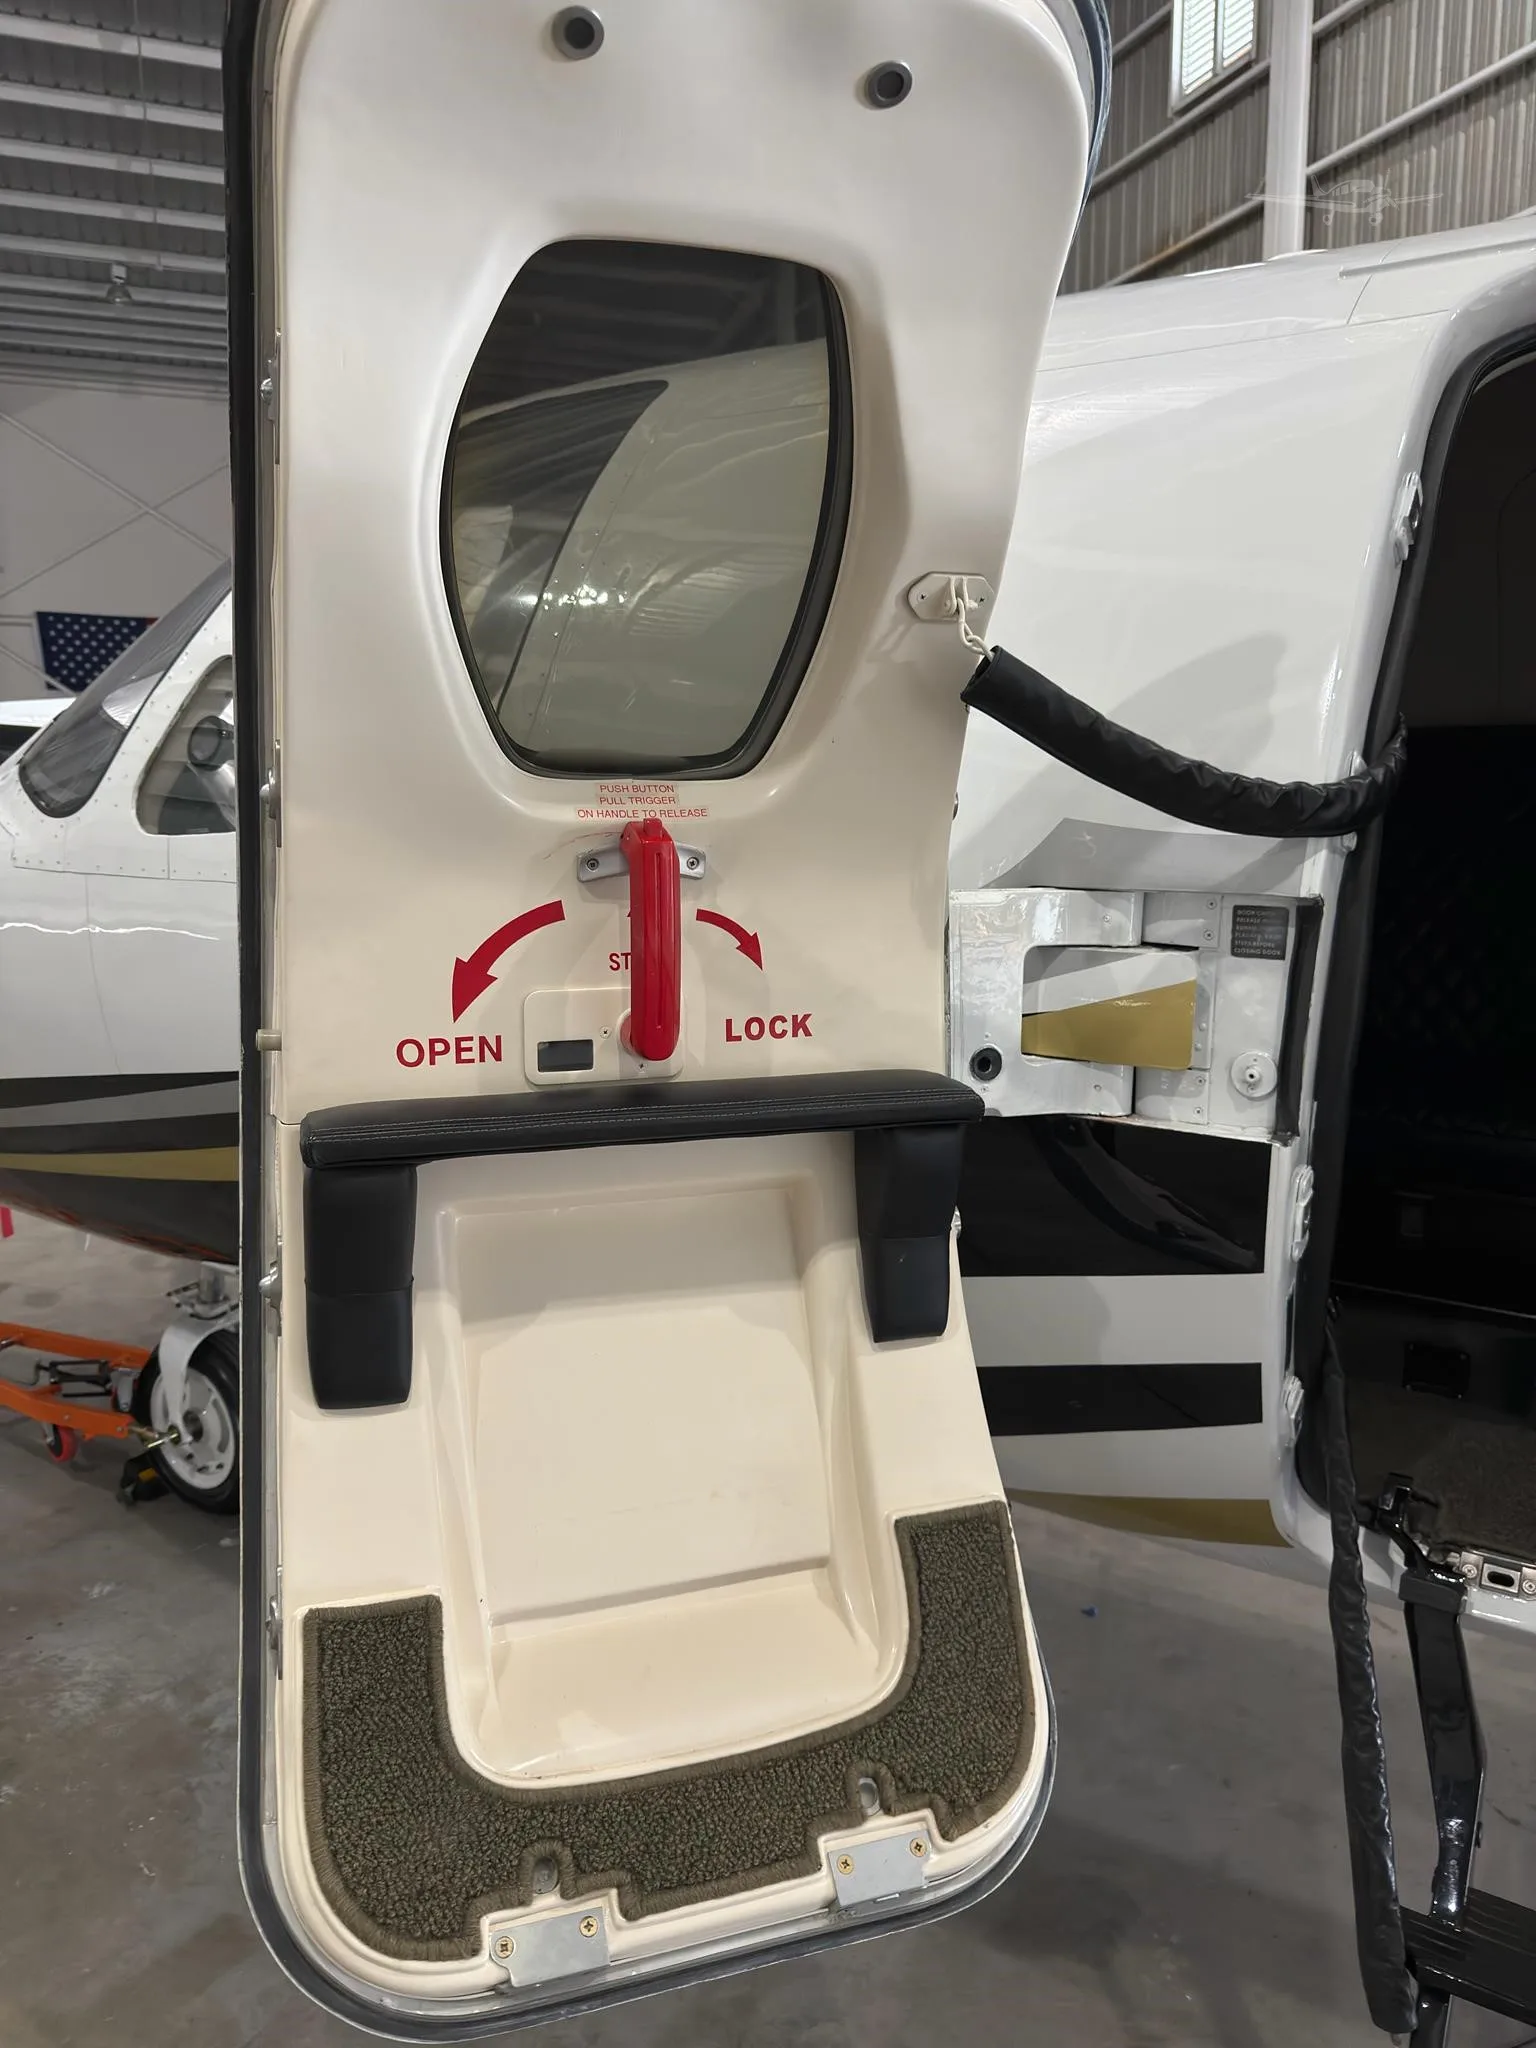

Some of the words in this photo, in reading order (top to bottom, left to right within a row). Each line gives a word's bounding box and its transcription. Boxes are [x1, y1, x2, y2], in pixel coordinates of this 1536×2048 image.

[599, 784, 630, 793] PUSH
[632, 784, 675, 793] BUTTON
[599, 796, 626, 805] PULL
[629, 796, 676, 805] TRIGGER
[577, 809, 594, 818] ON
[596, 809, 639, 818] HANDLE
[641, 809, 657, 818] TO
[660, 808, 708, 818] RELEASE
[609, 952, 631, 971] ST
[725, 1013, 813, 1042] LOCK
[396, 1035, 502, 1067] OPEN
